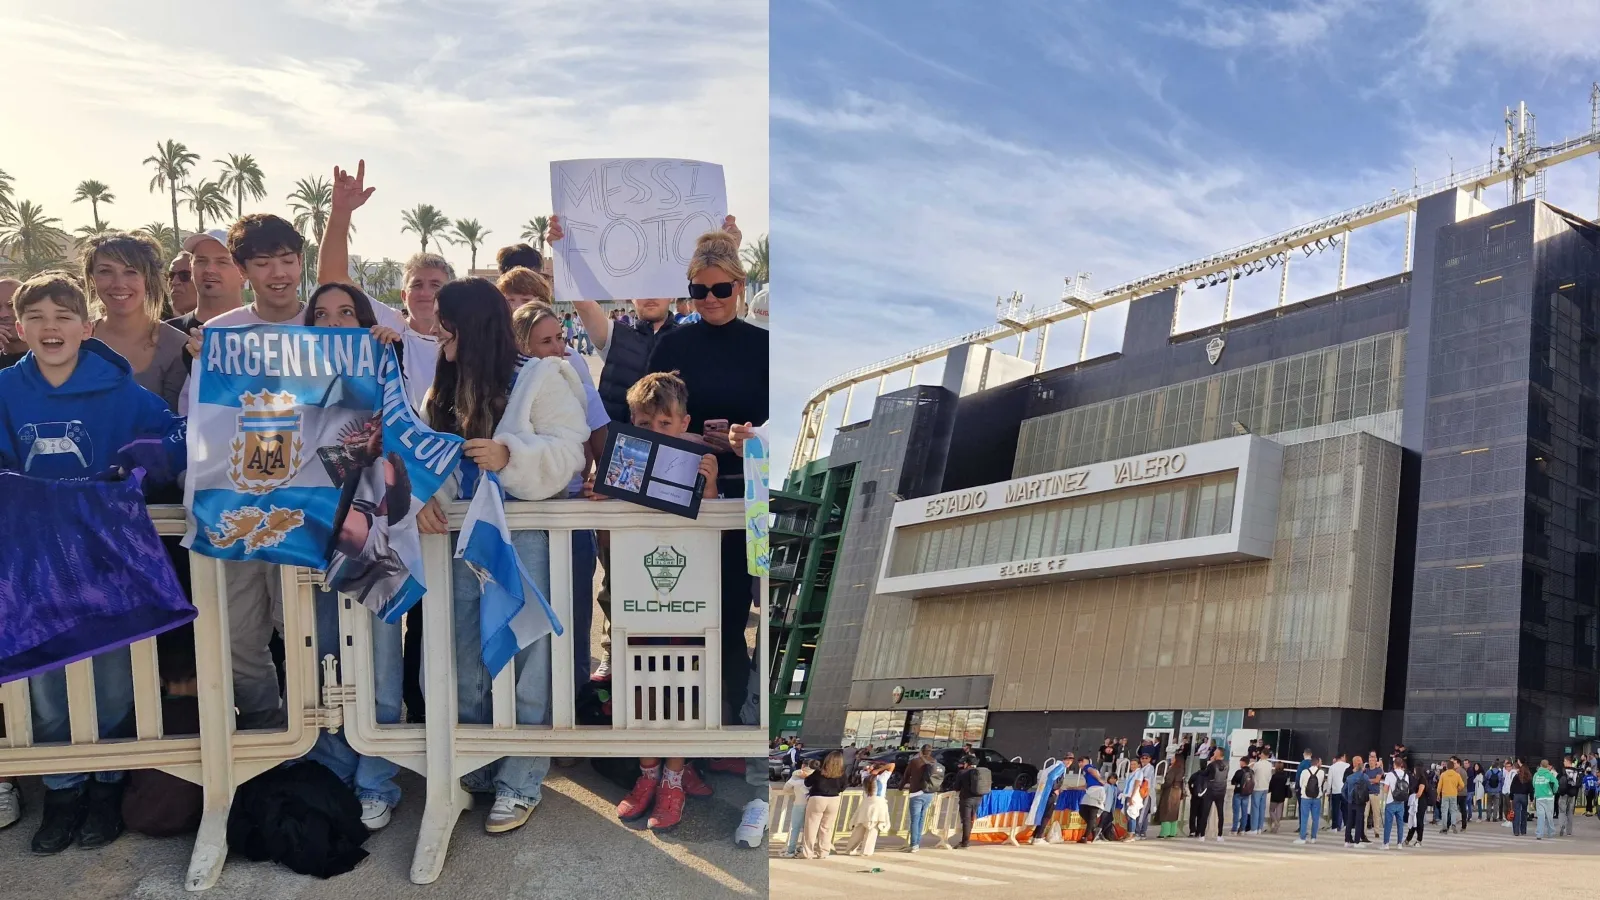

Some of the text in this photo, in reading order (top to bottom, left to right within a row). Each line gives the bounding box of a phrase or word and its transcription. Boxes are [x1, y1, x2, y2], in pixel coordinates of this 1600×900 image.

[207, 331, 376, 377] ARGENTINA
[247, 433, 286, 476] AFA
[924, 452, 1186, 518] ESTADIO MARTINEZ VALERO
[1000, 562, 1041, 576] ELCHE
[623, 599, 707, 613] ELCHECF
[1147, 711, 1156, 727] 0
